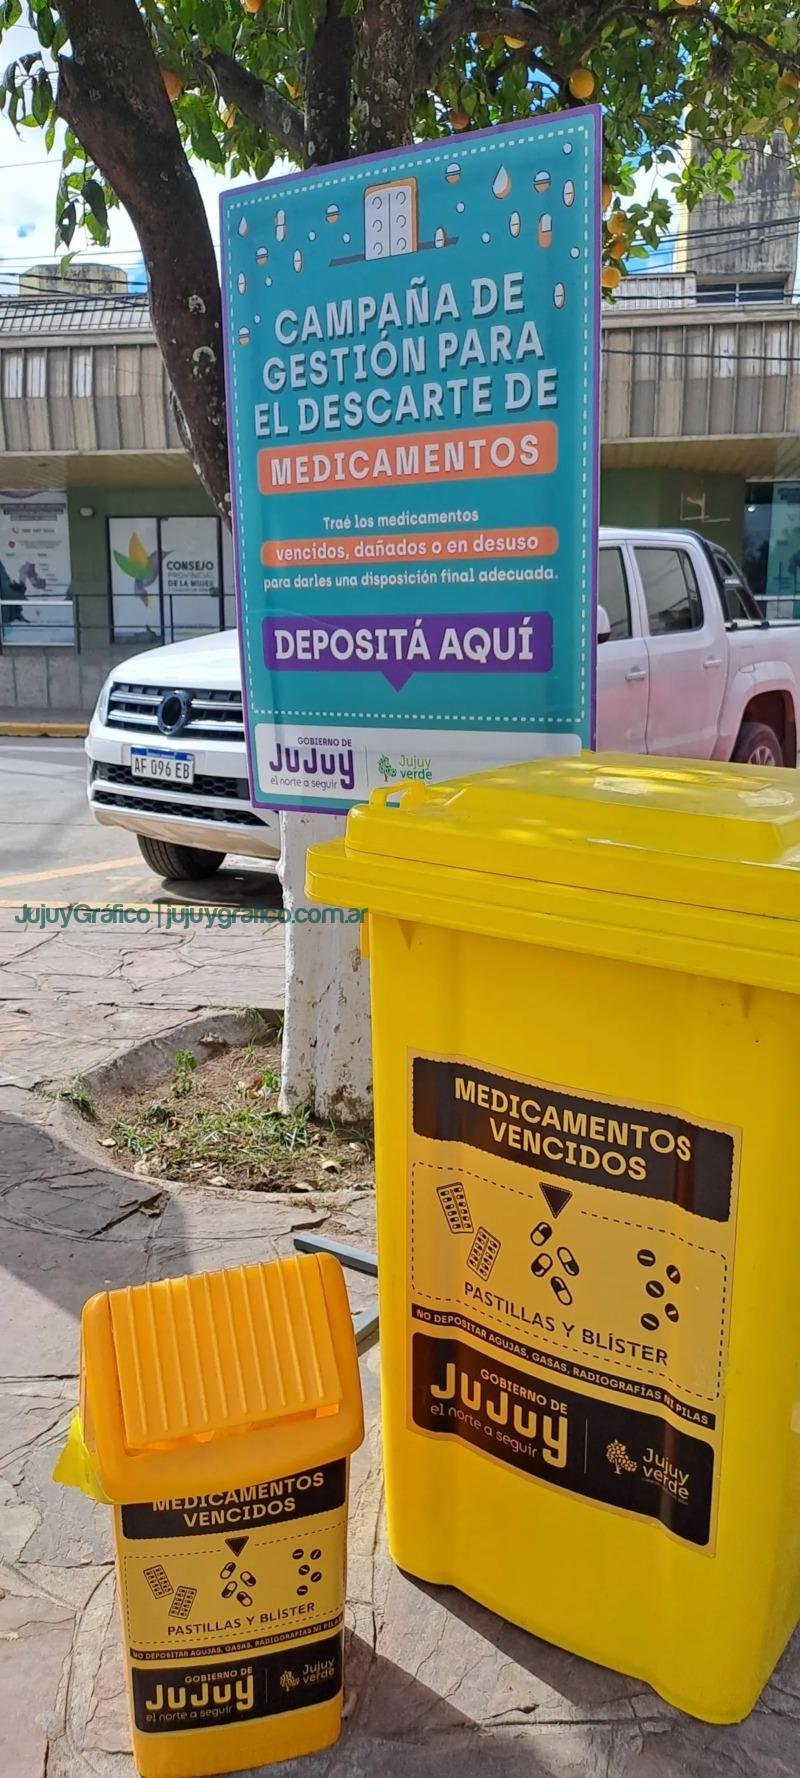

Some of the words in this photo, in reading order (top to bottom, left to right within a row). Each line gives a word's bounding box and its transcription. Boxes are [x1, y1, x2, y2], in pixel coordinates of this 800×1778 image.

[275, 276, 460, 345] CAMPAÑA
[471, 272, 524, 316] DE
[262, 331, 427, 392] GESTIÓN
[439, 320, 543, 369] PARA
[254, 402, 288, 437] EL
[298, 375, 492, 433] DESCARTE
[505, 368, 558, 410] DE
[271, 434, 539, 486] MEDICAMENTOS
[323, 515, 351, 531] Traé
[354, 514, 374, 529] los
[377, 508, 479, 527] medicamentos
[276, 541, 350, 562] vencidos,
[354, 537, 427, 560] dañados
[431, 541, 442, 555] o
[446, 539, 468, 554] en
[472, 533, 539, 553] desuso
[166, 560, 214, 571] CONSEJO
[263, 576, 291, 592] para
[294, 573, 332, 588] darles
[335, 575, 358, 588] una
[360, 570, 438, 590] disposición
[441, 567, 475, 584] final
[478, 566, 559, 583] adecuada.
[274, 619, 431, 662] DEPOSITÁ
[439, 616, 534, 664] AQUÍ
[297, 736, 338, 747] GOBIERNO
[338, 738, 353, 748] DE
[134, 757, 147, 773] AF
[151, 759, 172, 777] 096
[176, 762, 190, 779] EB
[400, 754, 431, 770] Jujuy
[400, 768, 433, 781] verde
[270, 776, 278, 788] el
[280, 778, 302, 789] norte
[303, 780, 310, 789] a
[311, 778, 338, 792] seguir
[454, 1077, 692, 1162] MEDICAMENTOS
[489, 1117, 647, 1181] VENCIDOS
[464, 1282, 555, 1332] PASTILLAS
[562, 1321, 576, 1338] Y
[582, 1327, 668, 1367] BLÍSTER
[416, 1308, 431, 1321] NO
[434, 1312, 487, 1339] DEPOSITAR
[488, 1333, 530, 1359] AGUJAS,
[531, 1351, 570, 1375] GASAS,
[573, 1365, 662, 1400] RADIOGRAFÍAS
[663, 1393, 674, 1407] NI
[675, 1402, 709, 1425] PILAS
[480, 1368, 547, 1406] GOBIERNO
[550, 1399, 568, 1415] DE
[430, 1403, 445, 1417] el
[448, 1406, 482, 1431] norte
[483, 1424, 493, 1436] a
[496, 1430, 538, 1458] seguir
[642, 1447, 690, 1486] Jujuy
[642, 1465, 690, 1500] verde
[152, 1472, 324, 1511] MEDICAMENTOS
[183, 1497, 297, 1528] VENCIDOS
[167, 1618, 241, 1636] PASTILLAS
[246, 1616, 255, 1626] Y
[260, 1602, 316, 1624] BLÍSTER
[132, 1650, 144, 1660] NO
[145, 1650, 189, 1660] DEPOSITAR
[313, 1625, 322, 1633] NI
[184, 1669, 238, 1684] GOBIERNO
[240, 1666, 253, 1676] DE
[302, 1656, 335, 1676] Jujuy
[302, 1667, 336, 1684] verde
[145, 1712, 156, 1723] el
[158, 1710, 188, 1722] norte
[190, 1710, 198, 1719] a
[200, 1704, 233, 1720] seguir
